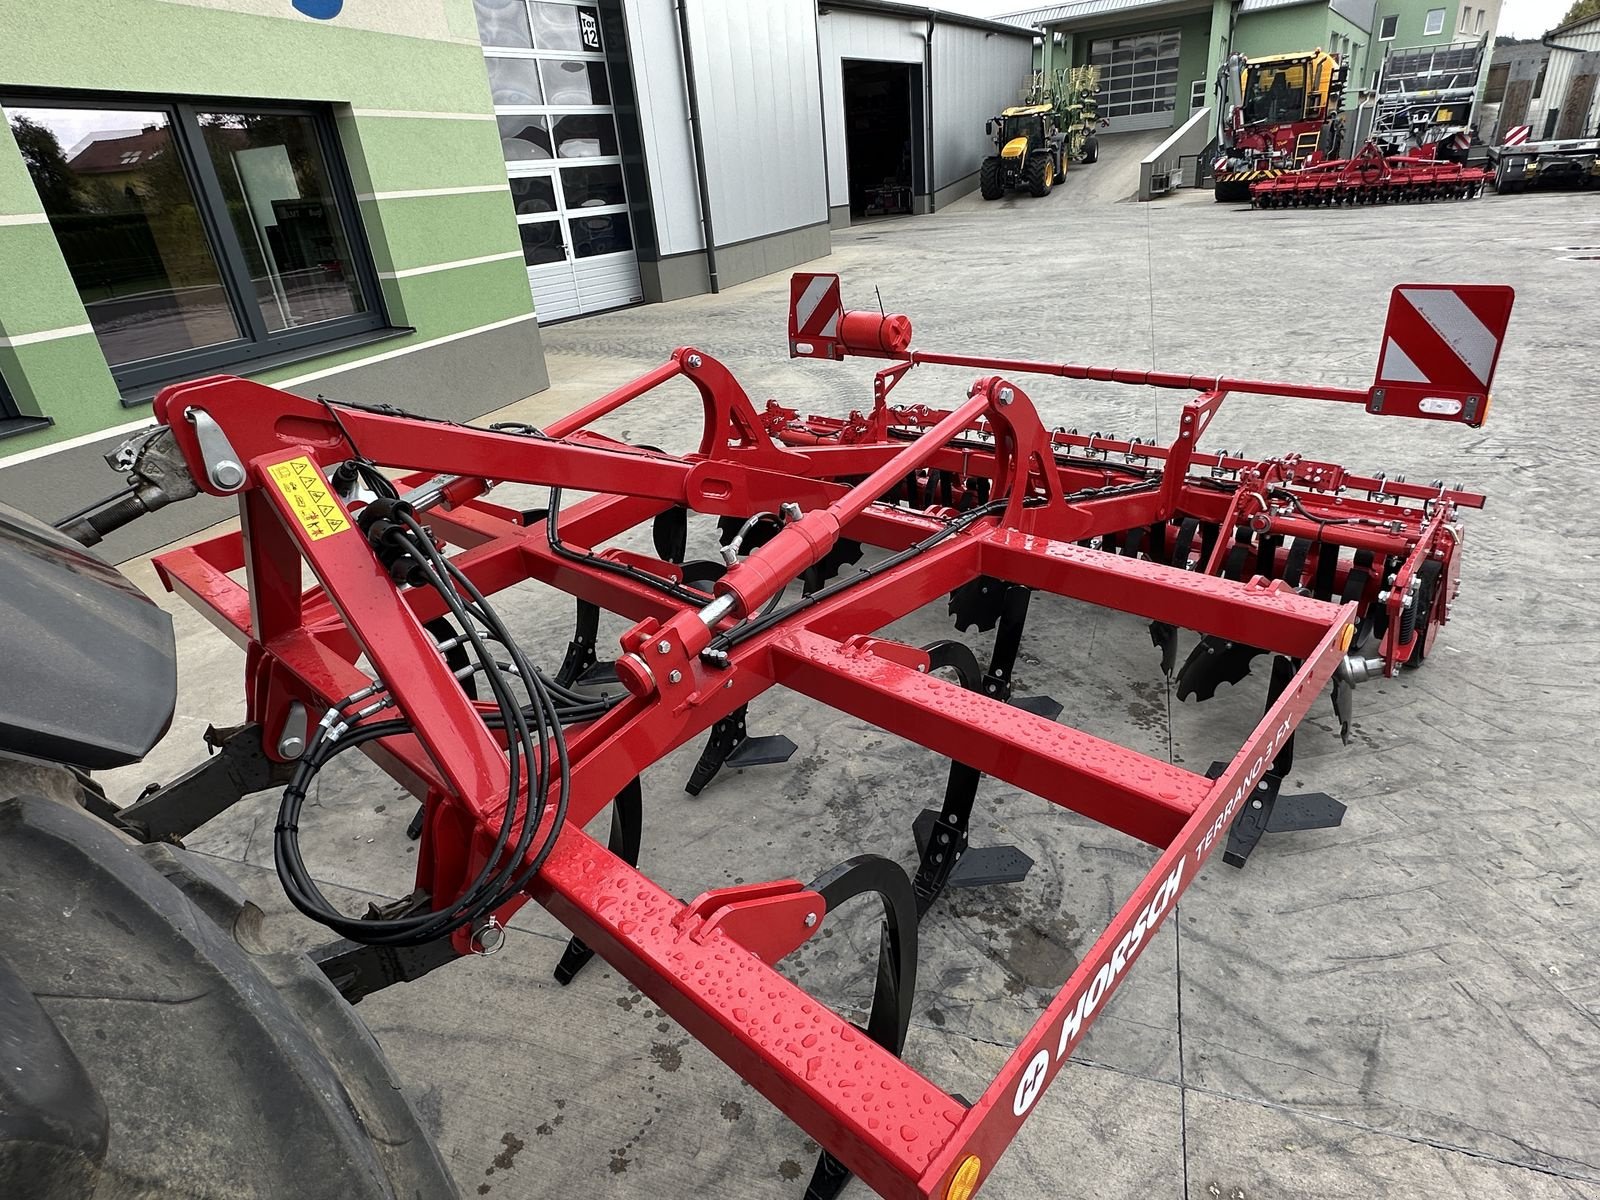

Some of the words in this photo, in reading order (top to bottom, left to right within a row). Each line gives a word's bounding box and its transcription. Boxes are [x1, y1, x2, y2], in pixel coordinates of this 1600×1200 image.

[581, 18, 595, 28] Tor
[584, 29, 598, 45] 12
[1195, 756, 1263, 861] TERRANO
[1264, 741, 1273, 762] 3
[1275, 712, 1293, 748] FX
[1056, 854, 1187, 1062] HORSCH
